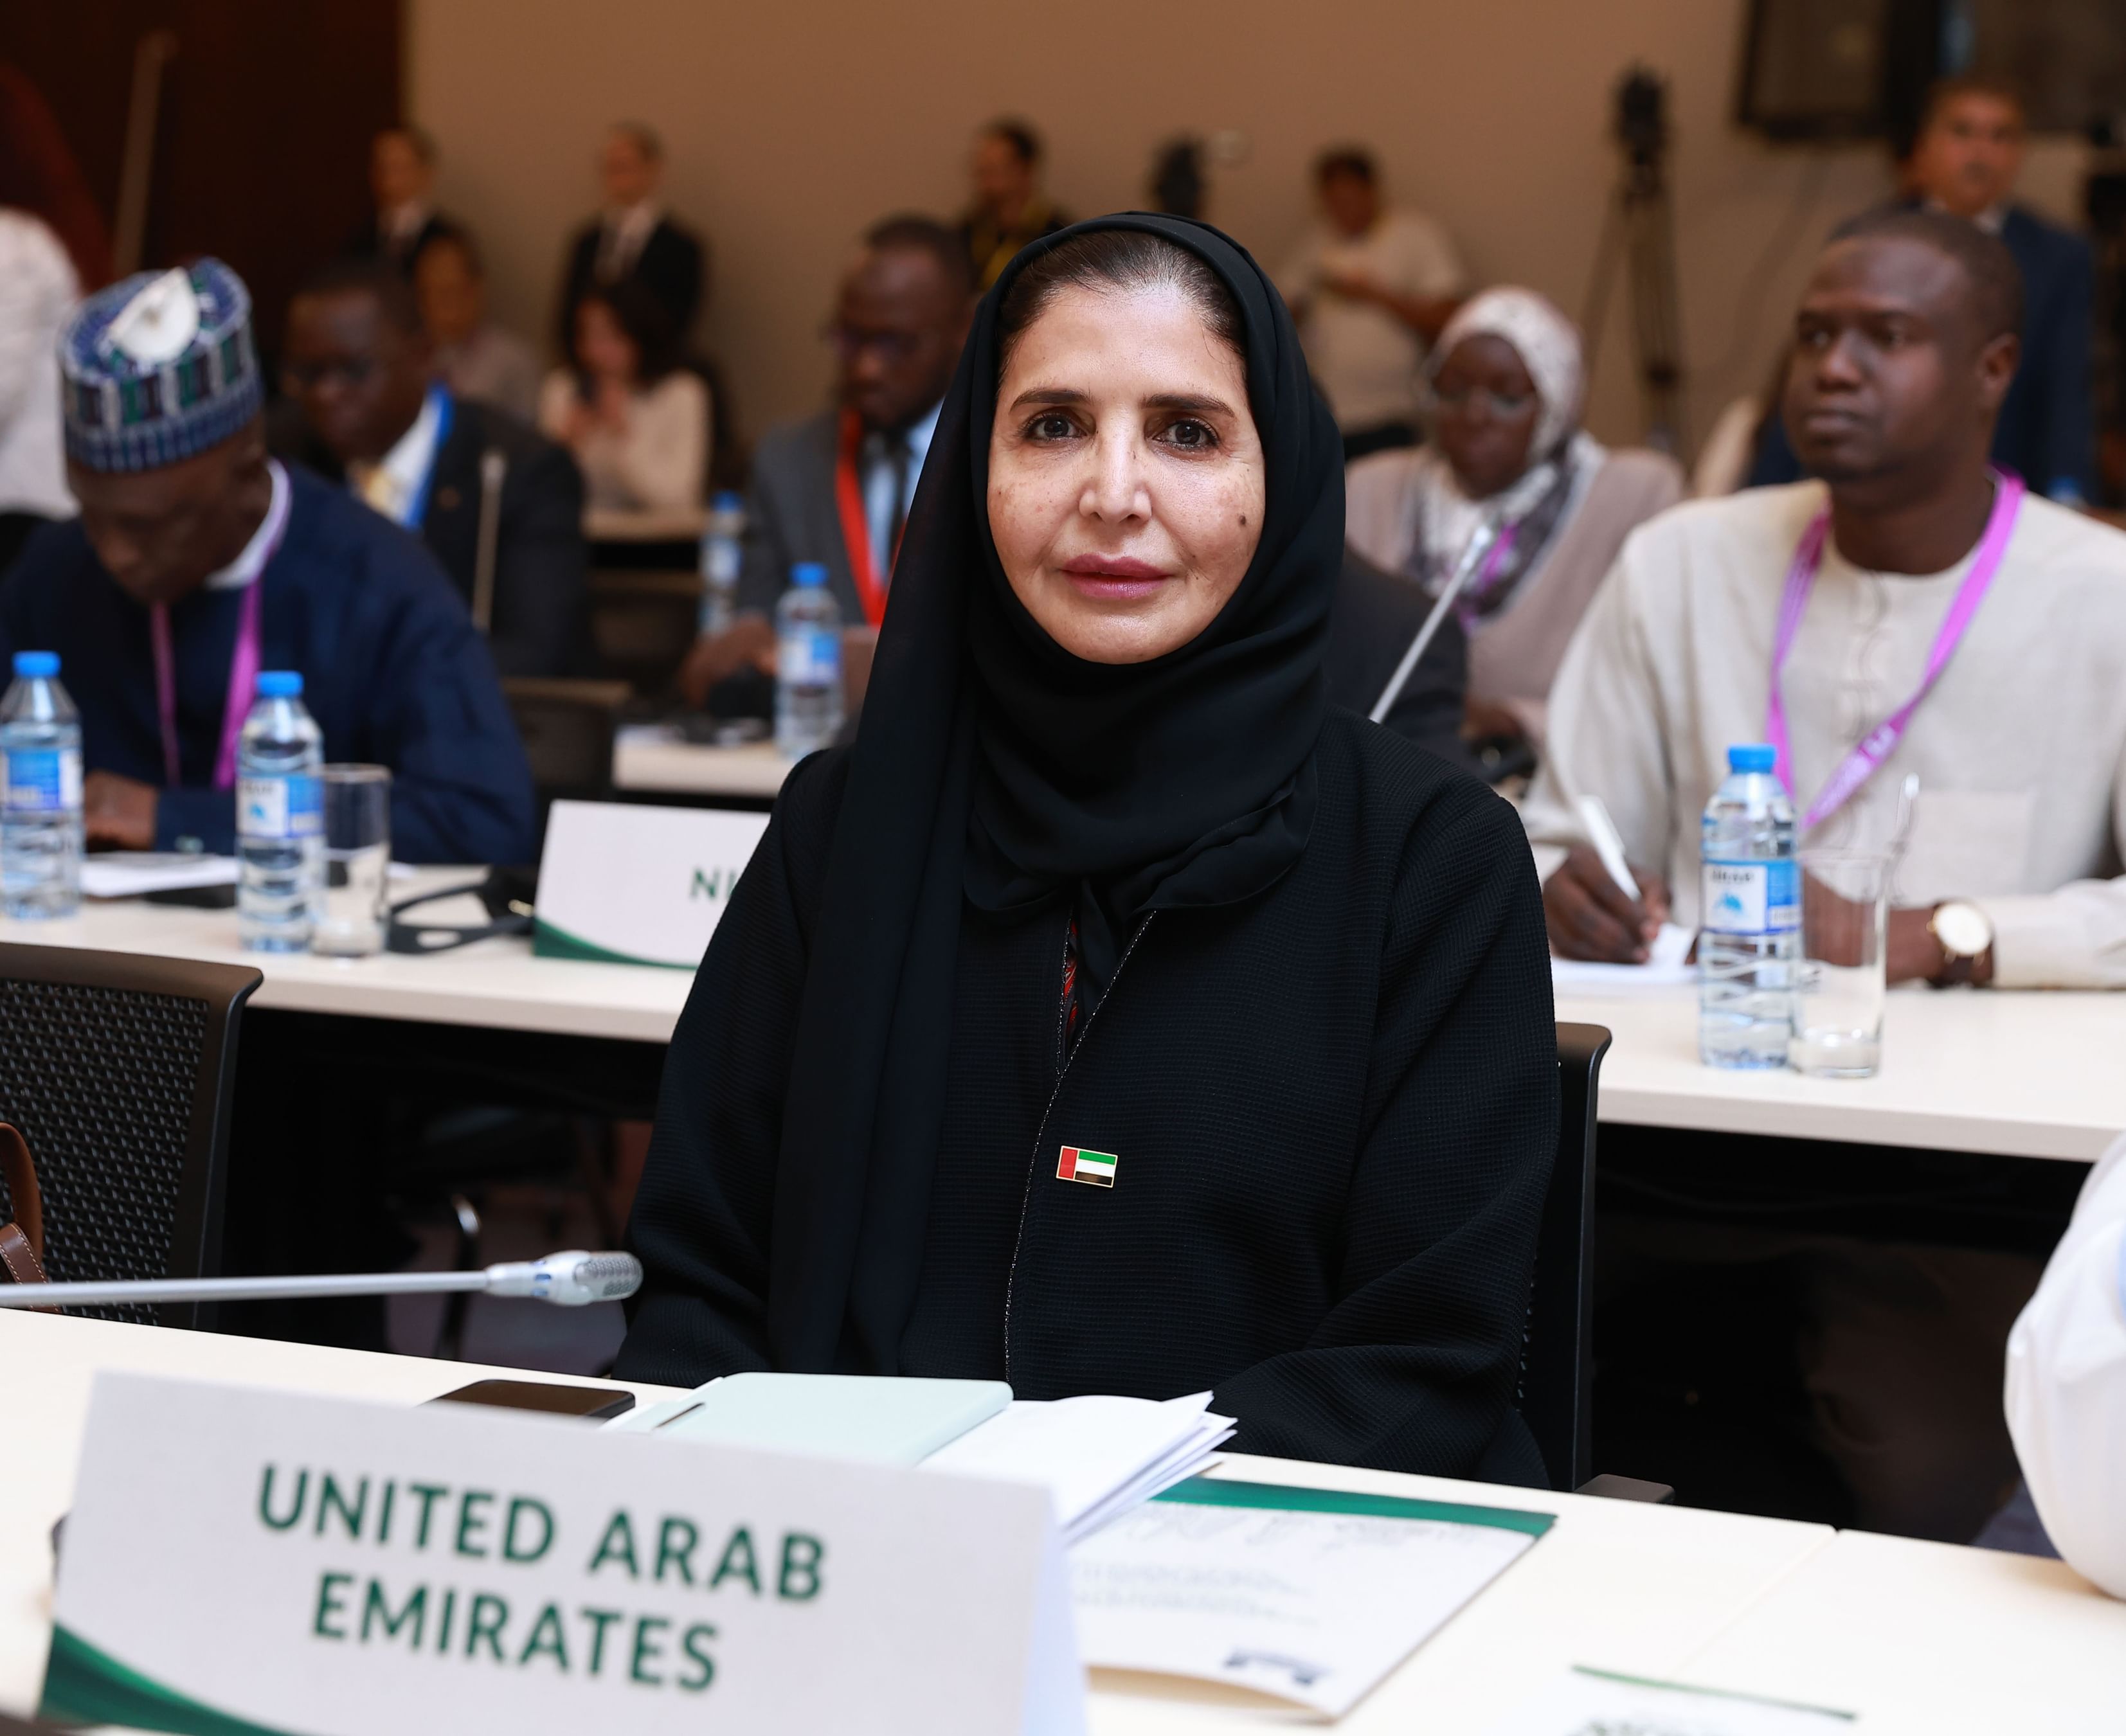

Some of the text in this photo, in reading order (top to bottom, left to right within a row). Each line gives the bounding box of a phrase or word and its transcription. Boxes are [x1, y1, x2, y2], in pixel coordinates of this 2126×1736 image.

[258, 1465, 826, 1602] UNITED ARAB
[312, 1571, 717, 1692] EMIRATES
